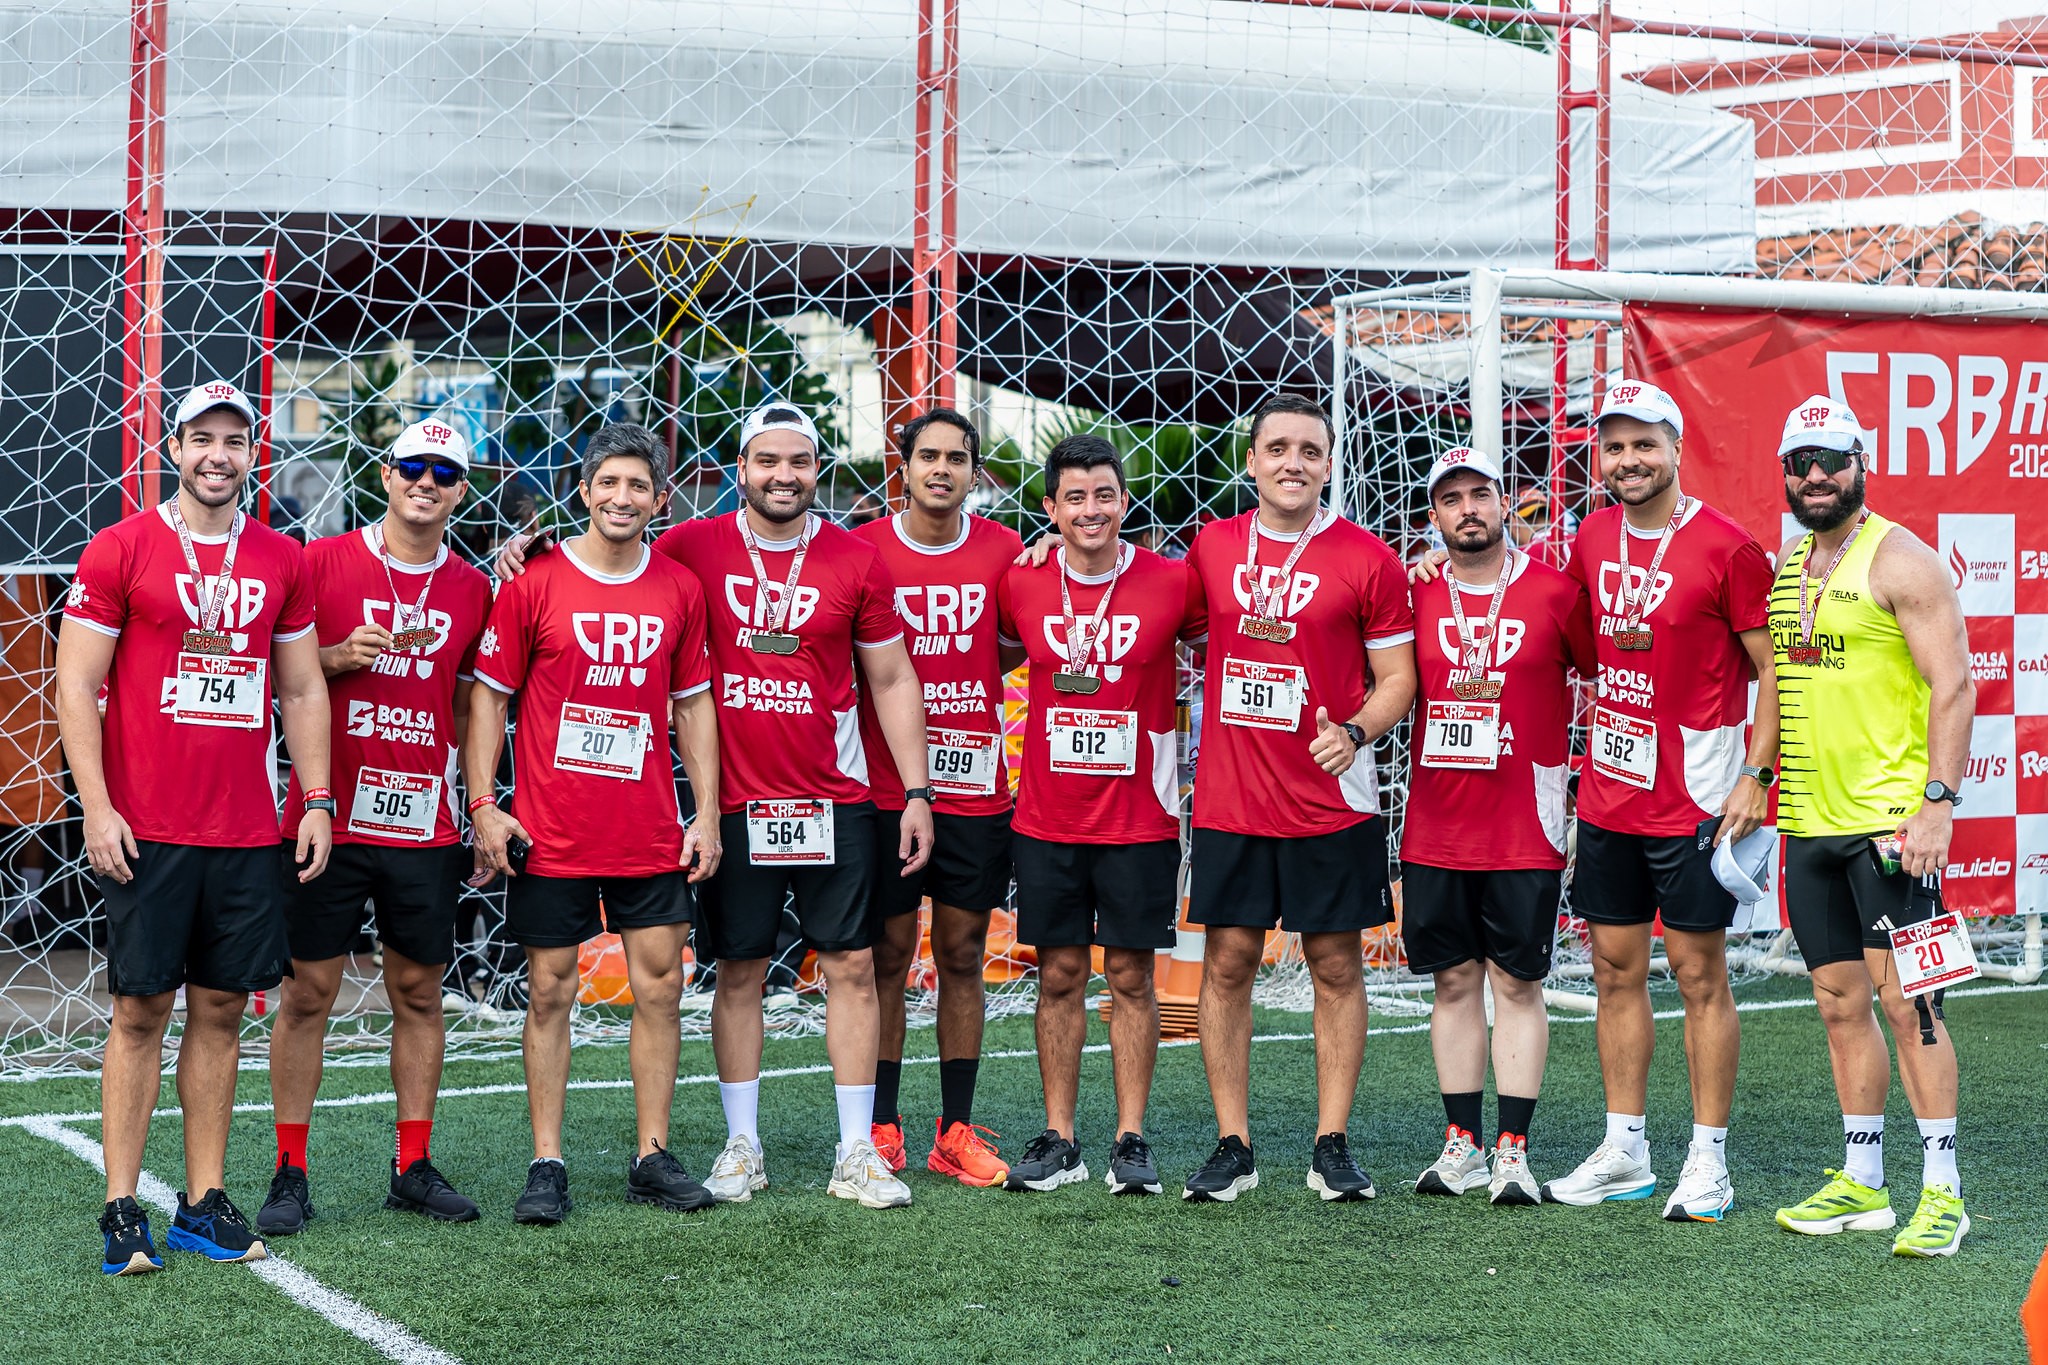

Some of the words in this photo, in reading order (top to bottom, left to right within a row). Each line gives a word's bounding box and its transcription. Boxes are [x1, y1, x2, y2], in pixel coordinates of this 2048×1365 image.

[204, 385, 235, 394] CRB
[1612, 386, 1641, 399] CRB
[1800, 408, 1830, 421] CRB
[1826, 351, 2009, 476] CRB
[422, 425, 452, 439] CRB
[1442, 449, 1469, 462] CRB
[1970, 561, 2008, 570] SUPORTE
[1974, 571, 2000, 582] SAÚDE
[1232, 564, 1320, 618] CRB
[1598, 560, 1674, 618] CRB
[175, 573, 266, 628] CRB
[725, 574, 820, 631] CRB
[895, 584, 986, 634] CRB
[572, 612, 664, 664] CRB
[1043, 614, 1140, 662] CRB
[1246, 621, 1272, 636] CRB
[185, 634, 212, 650] CRB
[394, 631, 415, 648] RB
[912, 635, 950, 656] RUN
[1438, 616, 1526, 668] CRB
[202, 658, 230, 674] CRB
[371, 653, 412, 678] RUN
[1968, 652, 2008, 668] BOLSA
[585, 665, 626, 687] RUN
[1244, 664, 1268, 680] CRB
[1608, 666, 1654, 696] BOLSA
[1972, 668, 2008, 680] APOSTA
[199, 677, 236, 704] 754
[748, 677, 813, 699] BOLSA
[924, 680, 987, 700] BOLSA
[1241, 682, 1273, 708] 561
[1455, 683, 1481, 698] CRB
[1482, 682, 1500, 692] RUN
[753, 698, 813, 714] APOSTA
[929, 700, 986, 716] APOSTA
[1444, 705, 1466, 720] CRB
[377, 705, 435, 731] BOLSA
[585, 710, 613, 726] CRB
[1074, 712, 1100, 727] CRB
[1610, 715, 1630, 733] CRB
[380, 727, 436, 746] APOSTA
[582, 731, 616, 756] 207
[942, 732, 968, 748] CRB
[1072, 730, 1106, 754] 612
[1440, 723, 1472, 747] 790
[1604, 732, 1634, 762] 562
[934, 749, 973, 774] 699
[382, 774, 408, 789] CRB
[942, 772, 960, 781] GABRIEL
[373, 791, 412, 817] 505
[769, 804, 796, 818] CRB
[767, 821, 806, 844] 564
[1907, 923, 1932, 942] CRB
[1915, 941, 1944, 970] 20
[1846, 1130, 1883, 1144] 10K
